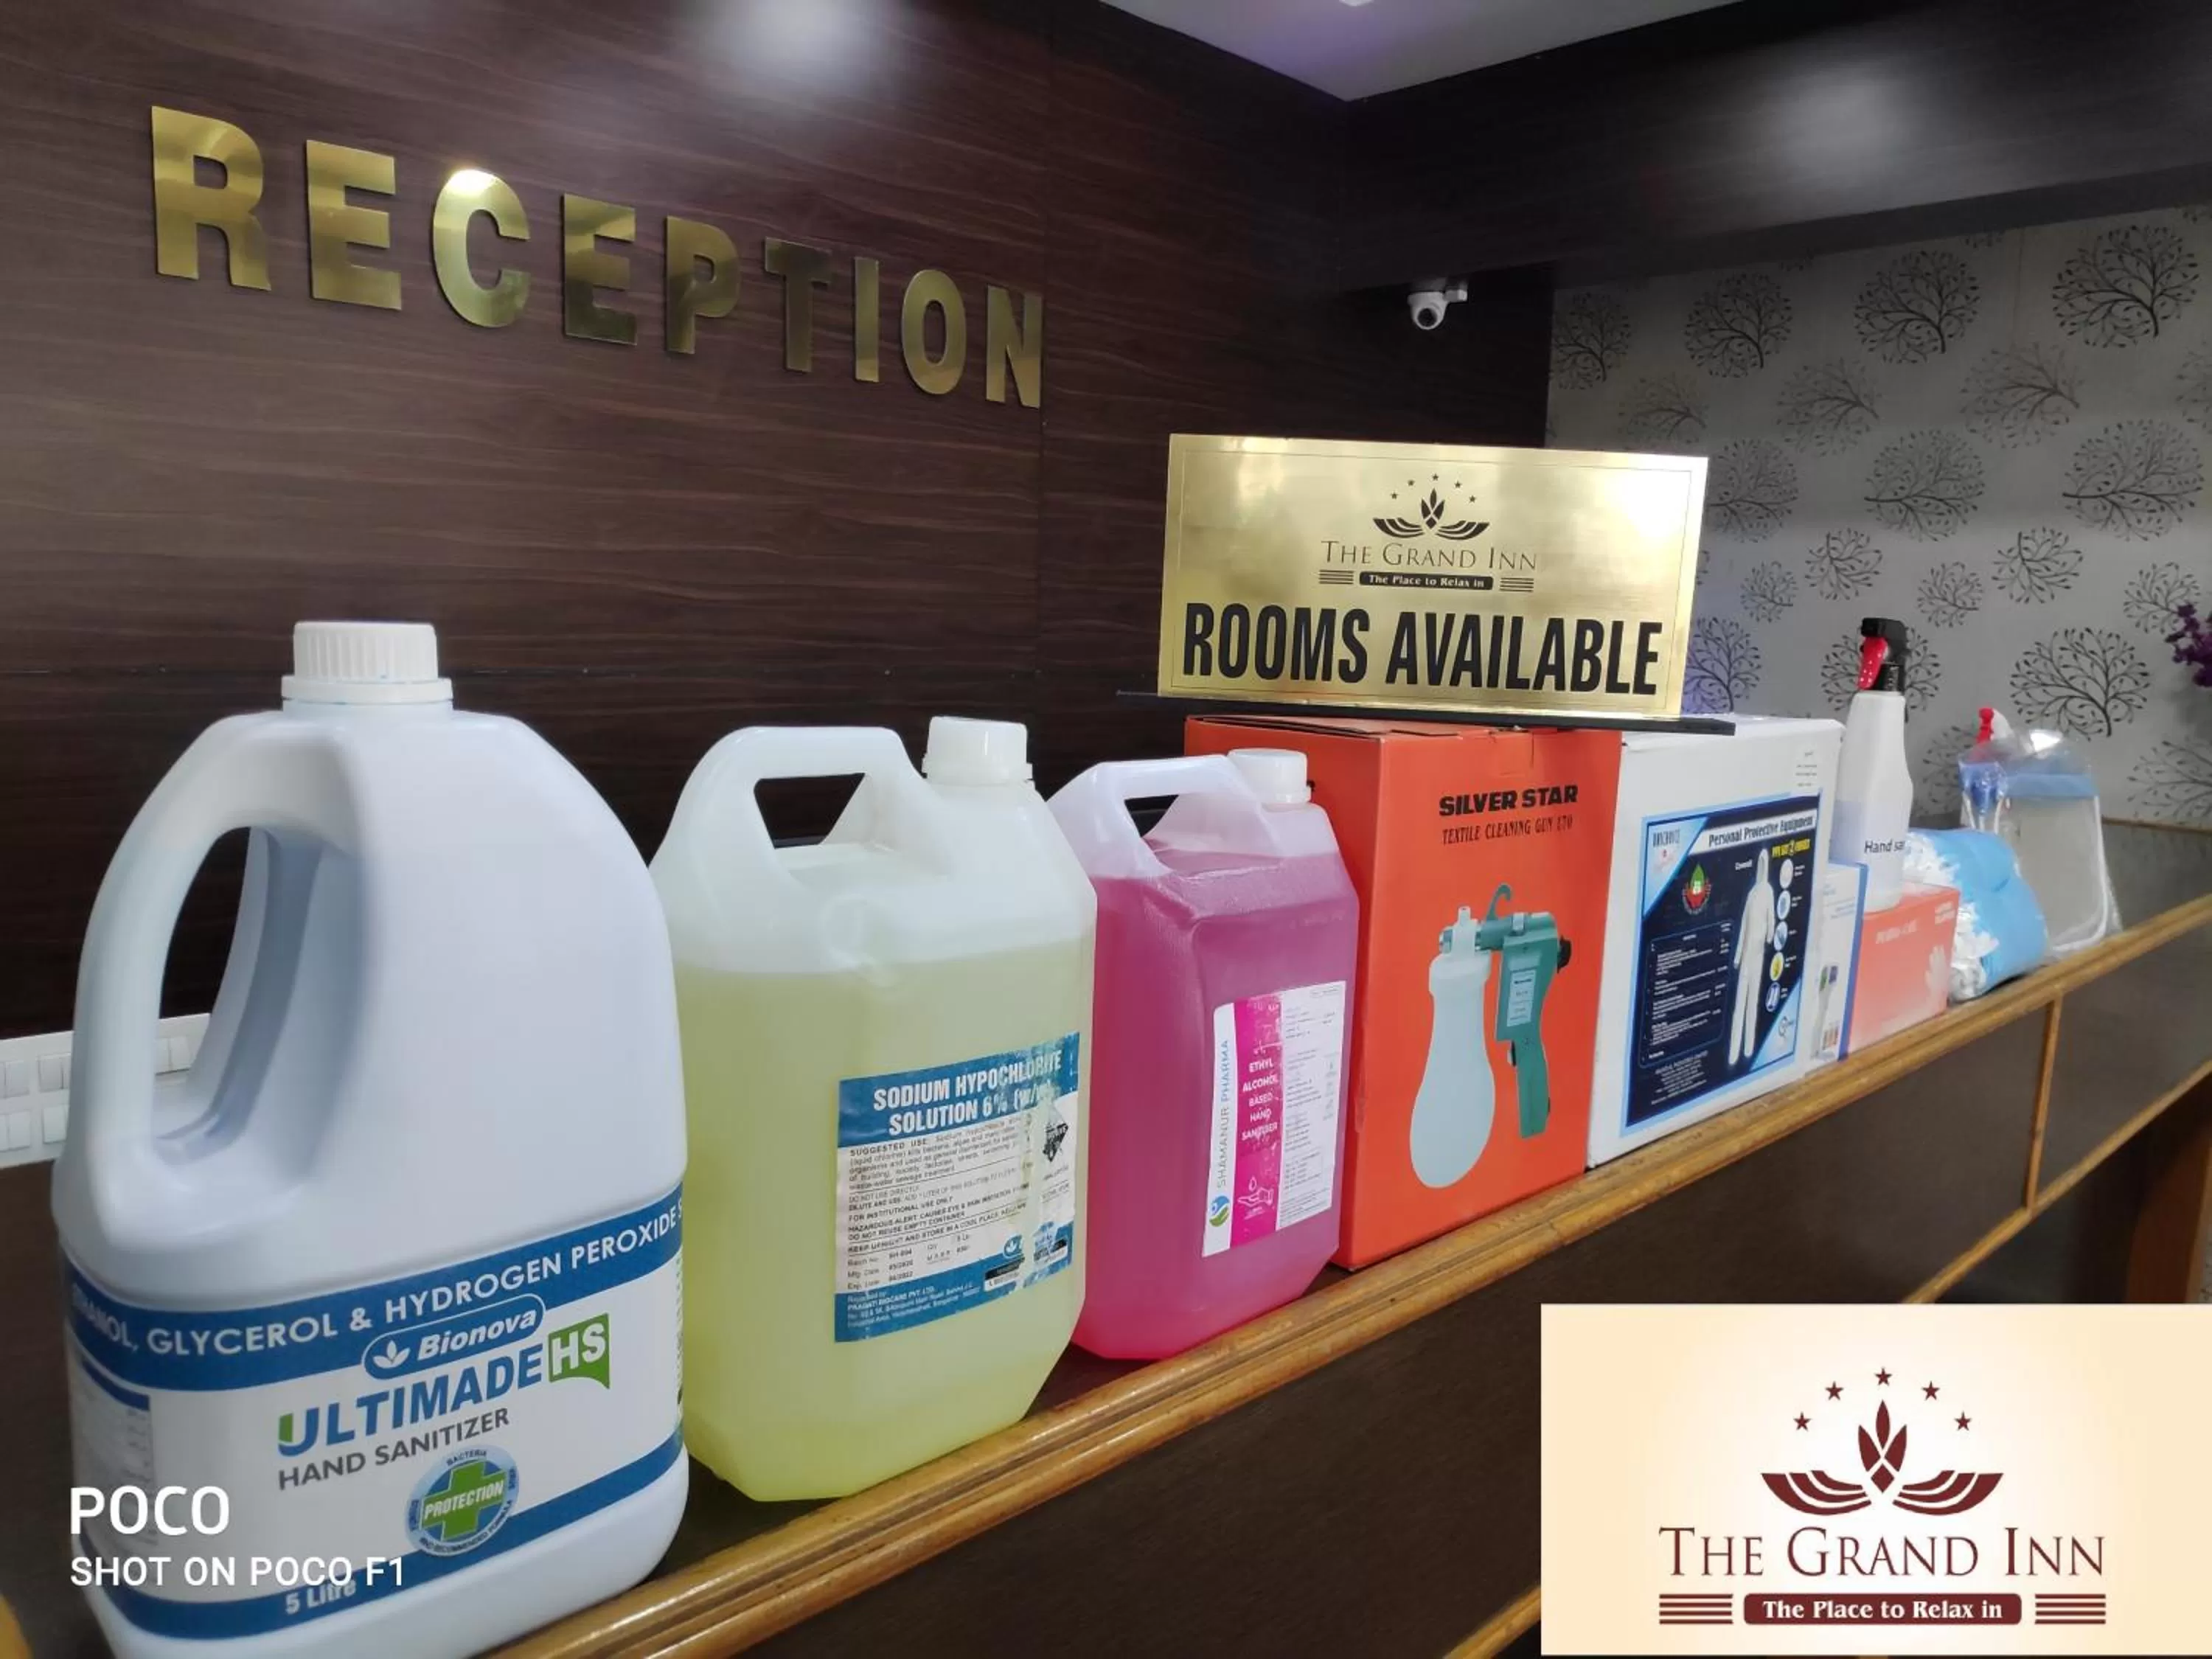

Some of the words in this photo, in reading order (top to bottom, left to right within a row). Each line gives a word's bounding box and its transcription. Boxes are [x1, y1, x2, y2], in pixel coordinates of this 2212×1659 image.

[152, 105, 1043, 409] RECEPTION
[1321, 540, 1371, 565] THE
[1382, 543, 1477, 568] GRAND
[1489, 547, 1537, 571] INN
[1368, 574, 1389, 585] The
[1392, 576, 1422, 586] Place
[1425, 577, 1438, 586] to
[1440, 578, 1470, 588] Relax
[1473, 579, 1485, 588] in
[1183, 602, 1370, 684] ROOMS
[1385, 611, 1663, 696] AVAILABLE
[1439, 790, 1518, 817] SILVER
[1521, 784, 1579, 808] STAR
[1442, 824, 1481, 845] TEXTILE
[1485, 819, 1531, 840] CLEANING
[1708, 828, 1743, 847] Personal
[1864, 840, 1892, 853] Hand
[873, 1078, 951, 1111] SODIUM
[954, 1049, 1063, 1097] HYPOCHLORITE
[1220, 1040, 1230, 1103] PHARMA
[1248, 1057, 1274, 1073] ETHYL
[1242, 1073, 1279, 1092] ALCOHOL
[1248, 1091, 1273, 1107] BASED
[1250, 1107, 1272, 1122] HAND
[888, 1101, 979, 1136] SOLUTION
[849, 1141, 905, 1157] SUGGESTED
[1217, 1107, 1230, 1189] SHAMANUR
[147, 1313, 338, 1355] GLYCEROL
[349, 1307, 372, 1331] &
[385, 1253, 563, 1324] HYDROGEN
[571, 1209, 678, 1269] PEROXIDE
[417, 1308, 537, 1361] Bionova
[279, 1452, 366, 1491] HAND
[375, 1407, 510, 1467] SANITIZER
[424, 1480, 504, 1520] PROTECTION
[285, 1593, 300, 1615] 5
